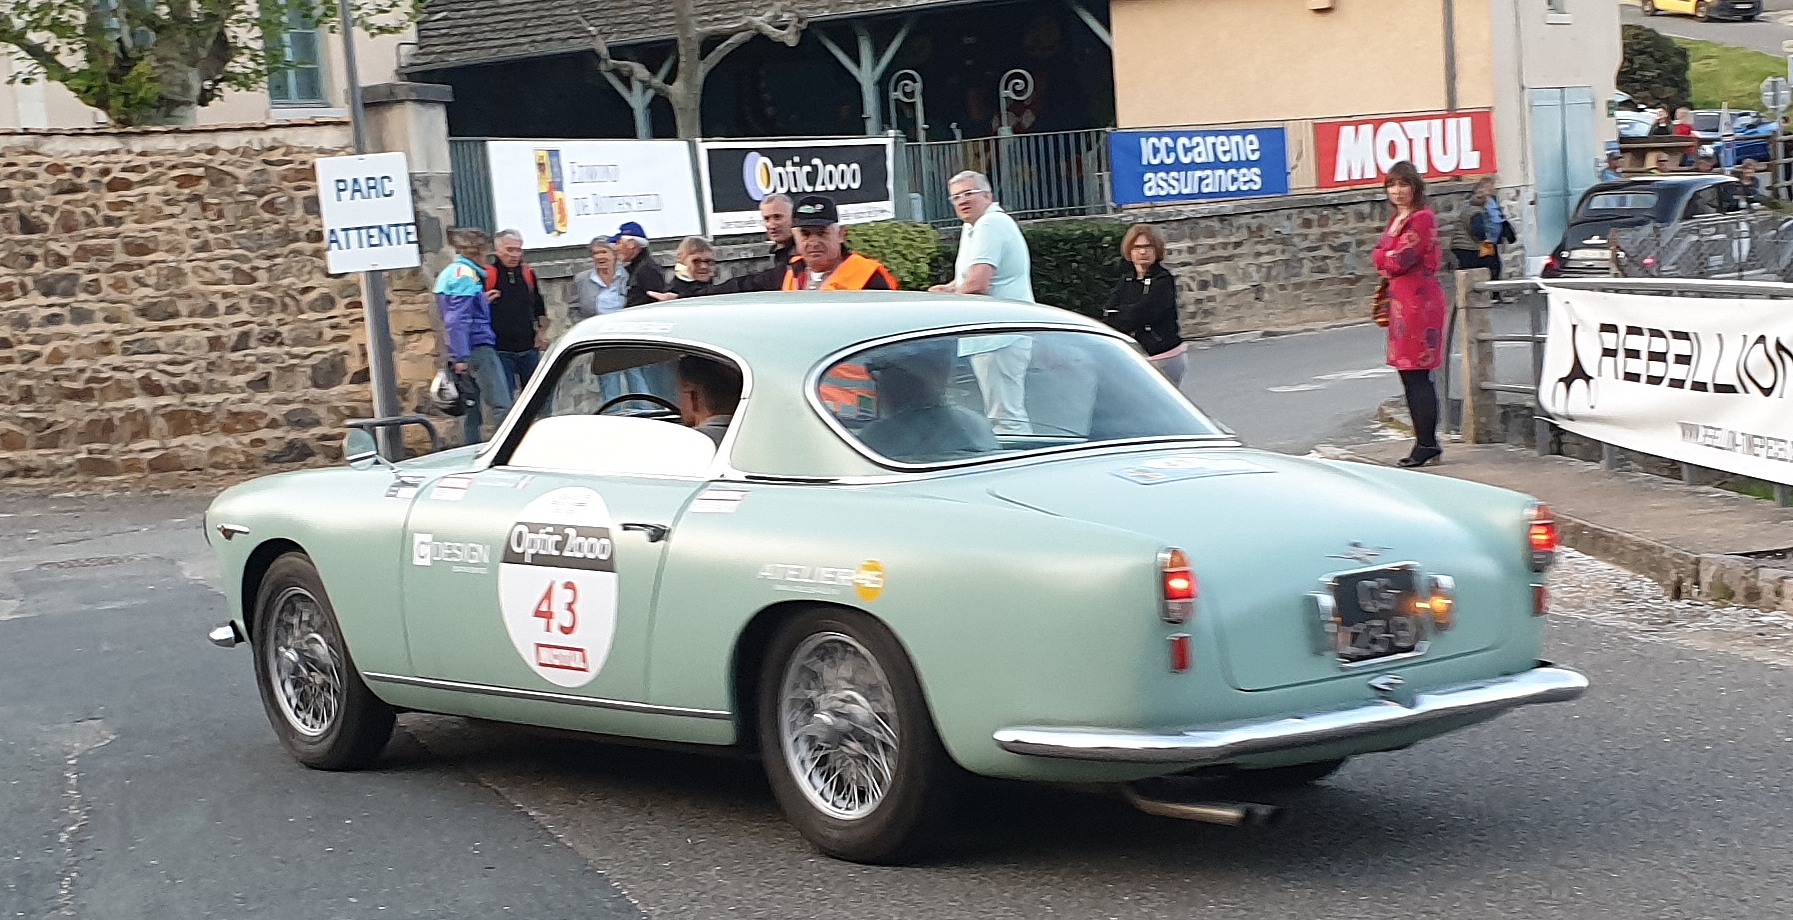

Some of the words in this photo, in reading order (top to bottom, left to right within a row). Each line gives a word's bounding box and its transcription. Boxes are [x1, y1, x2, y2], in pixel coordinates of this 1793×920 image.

[1335, 117, 1480, 181] MOTUL
[334, 175, 395, 202] PARC
[1143, 167, 1262, 197] assurances
[327, 222, 419, 251] ATTENTE
[511, 525, 561, 562] Optic
[561, 527, 612, 561] 2000
[532, 579, 580, 636] 43
